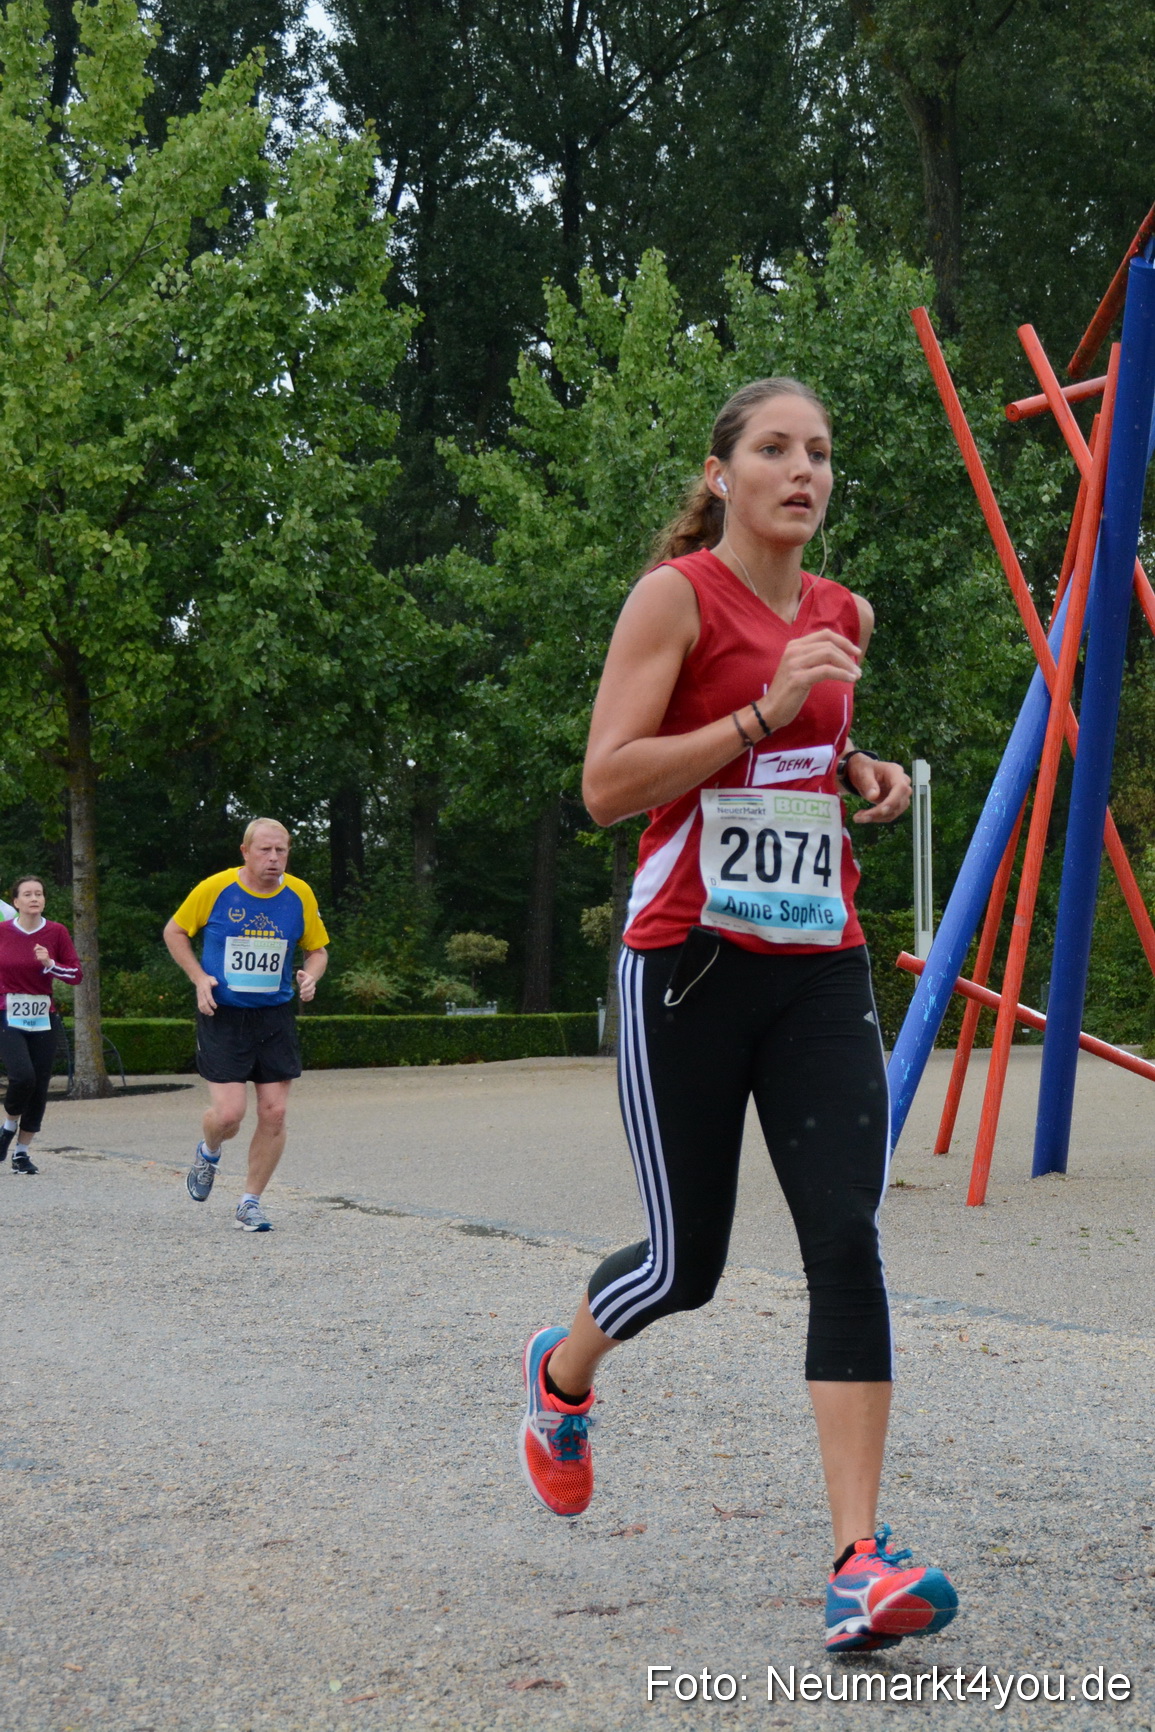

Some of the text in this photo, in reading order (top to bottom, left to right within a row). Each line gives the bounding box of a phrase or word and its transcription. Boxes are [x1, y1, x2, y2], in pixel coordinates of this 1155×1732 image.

[776, 757, 814, 773] DEHN
[774, 796, 831, 819] BOCK
[720, 826, 832, 888] 2074
[722, 895, 773, 920] Anne
[780, 899, 834, 928] Sophie
[231, 950, 281, 973] 3048
[12, 1001, 48, 1017] 2302
